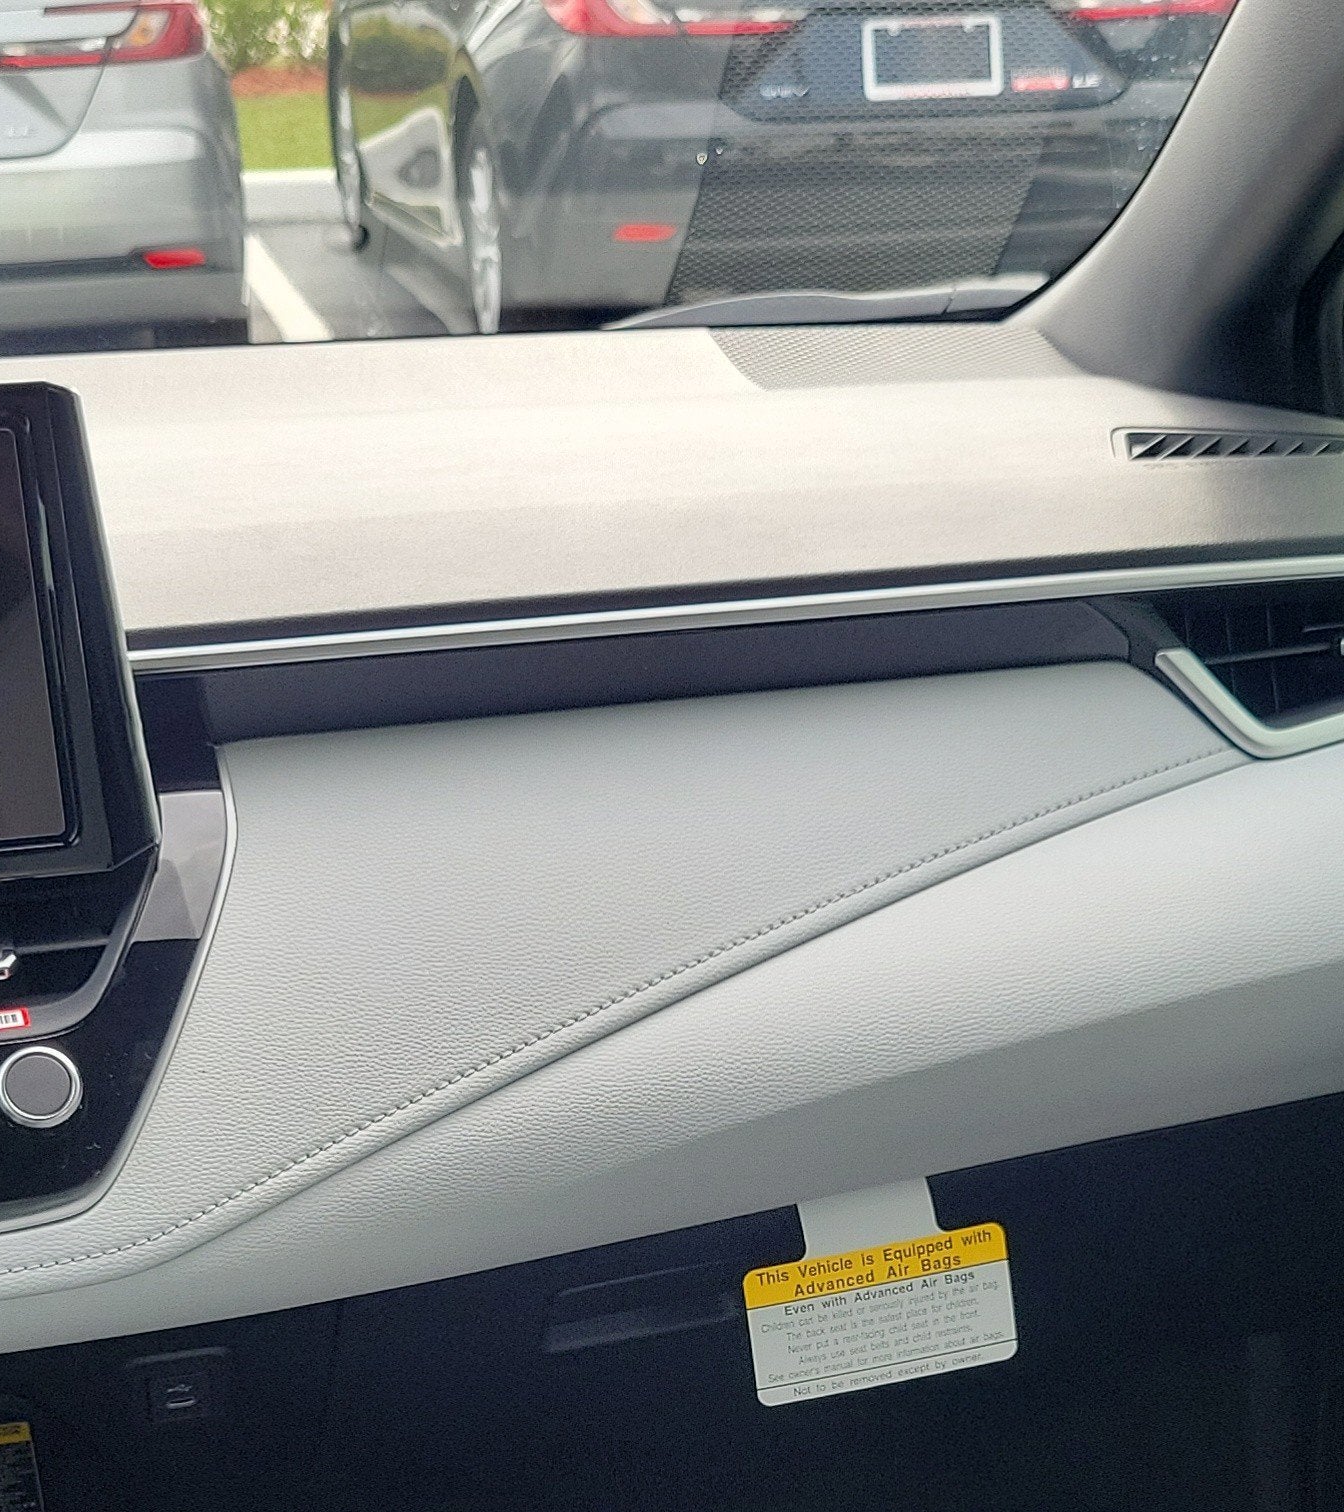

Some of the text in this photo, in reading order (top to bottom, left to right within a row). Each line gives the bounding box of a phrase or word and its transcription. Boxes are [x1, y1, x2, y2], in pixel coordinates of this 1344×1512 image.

[756, 1229, 991, 1286] This Vehicle is Equipped with
[794, 1255, 961, 1297] Advanced Air Bags
[784, 1271, 975, 1316] Even with Advanced Air Bags
[793, 1386, 811, 1397] Not
[816, 1383, 826, 1392] to
